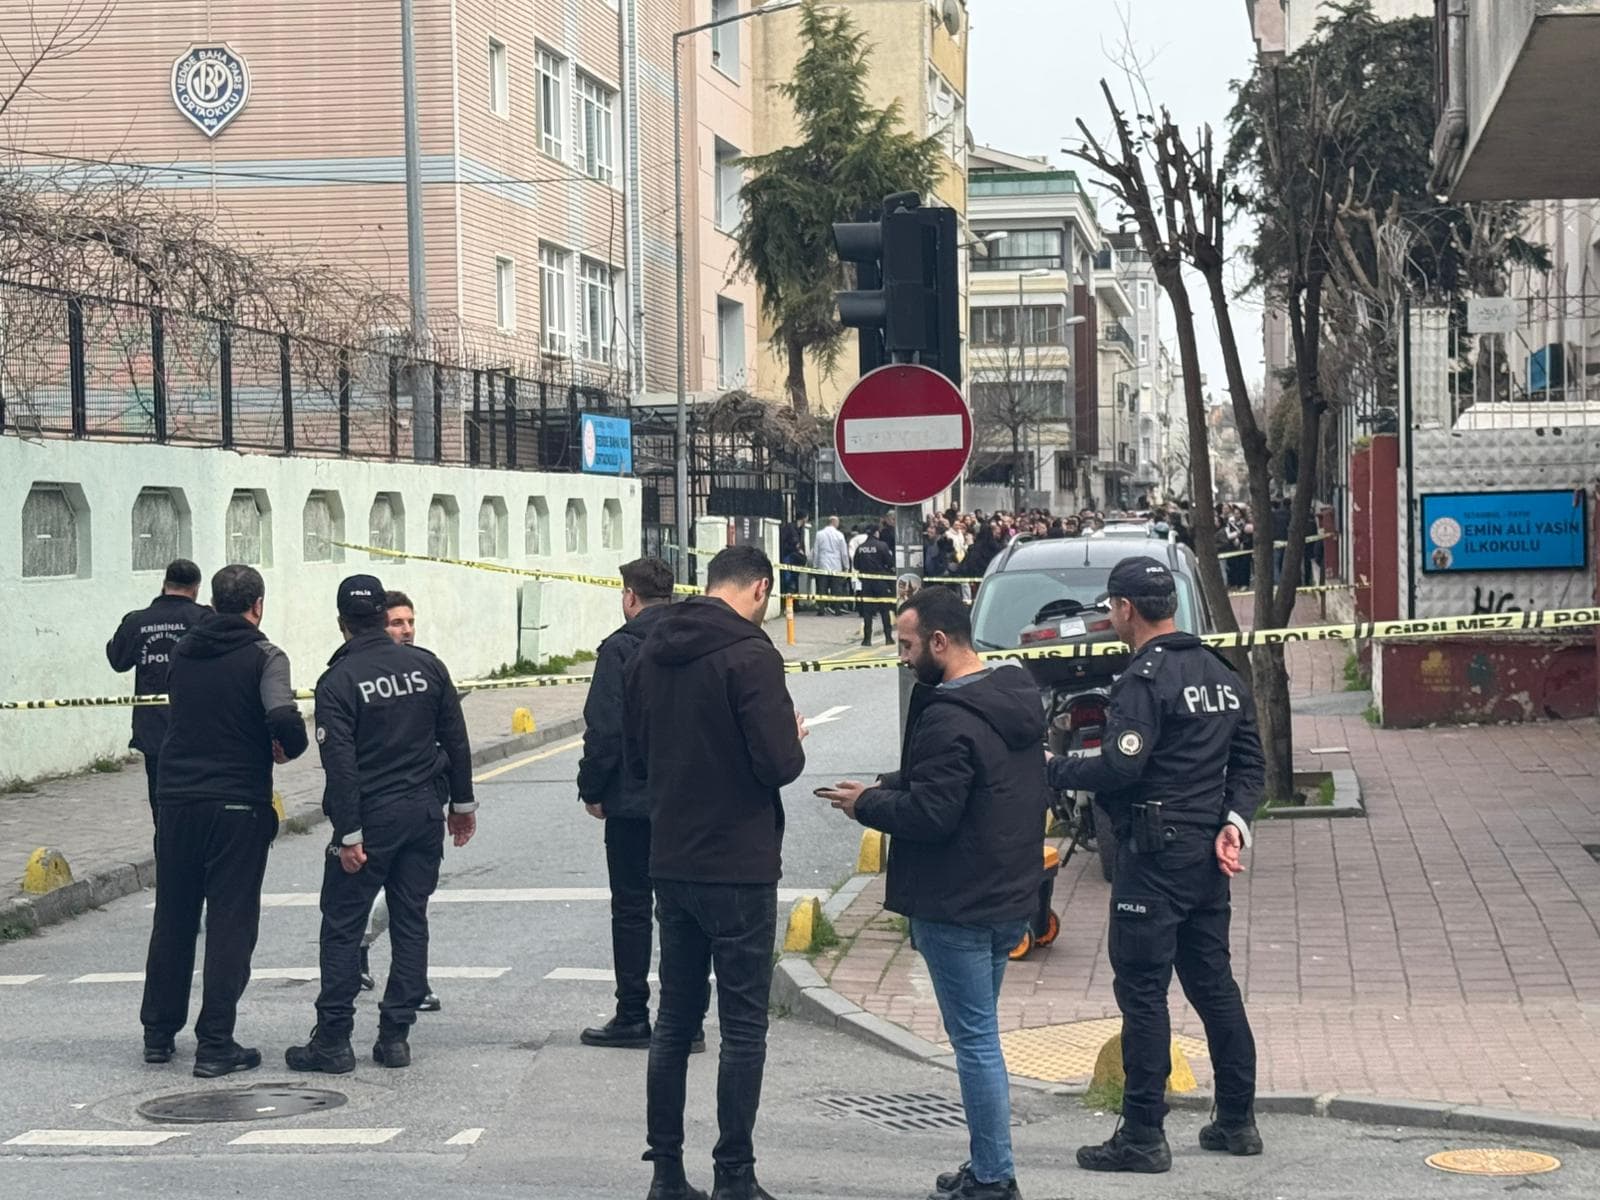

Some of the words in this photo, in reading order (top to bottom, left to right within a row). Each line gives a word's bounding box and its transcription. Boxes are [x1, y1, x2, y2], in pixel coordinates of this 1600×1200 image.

[199, 51, 227, 64] BAHA
[181, 93, 239, 117] ORTAOKULU
[1465, 538, 1540, 553] İLKOKULU
